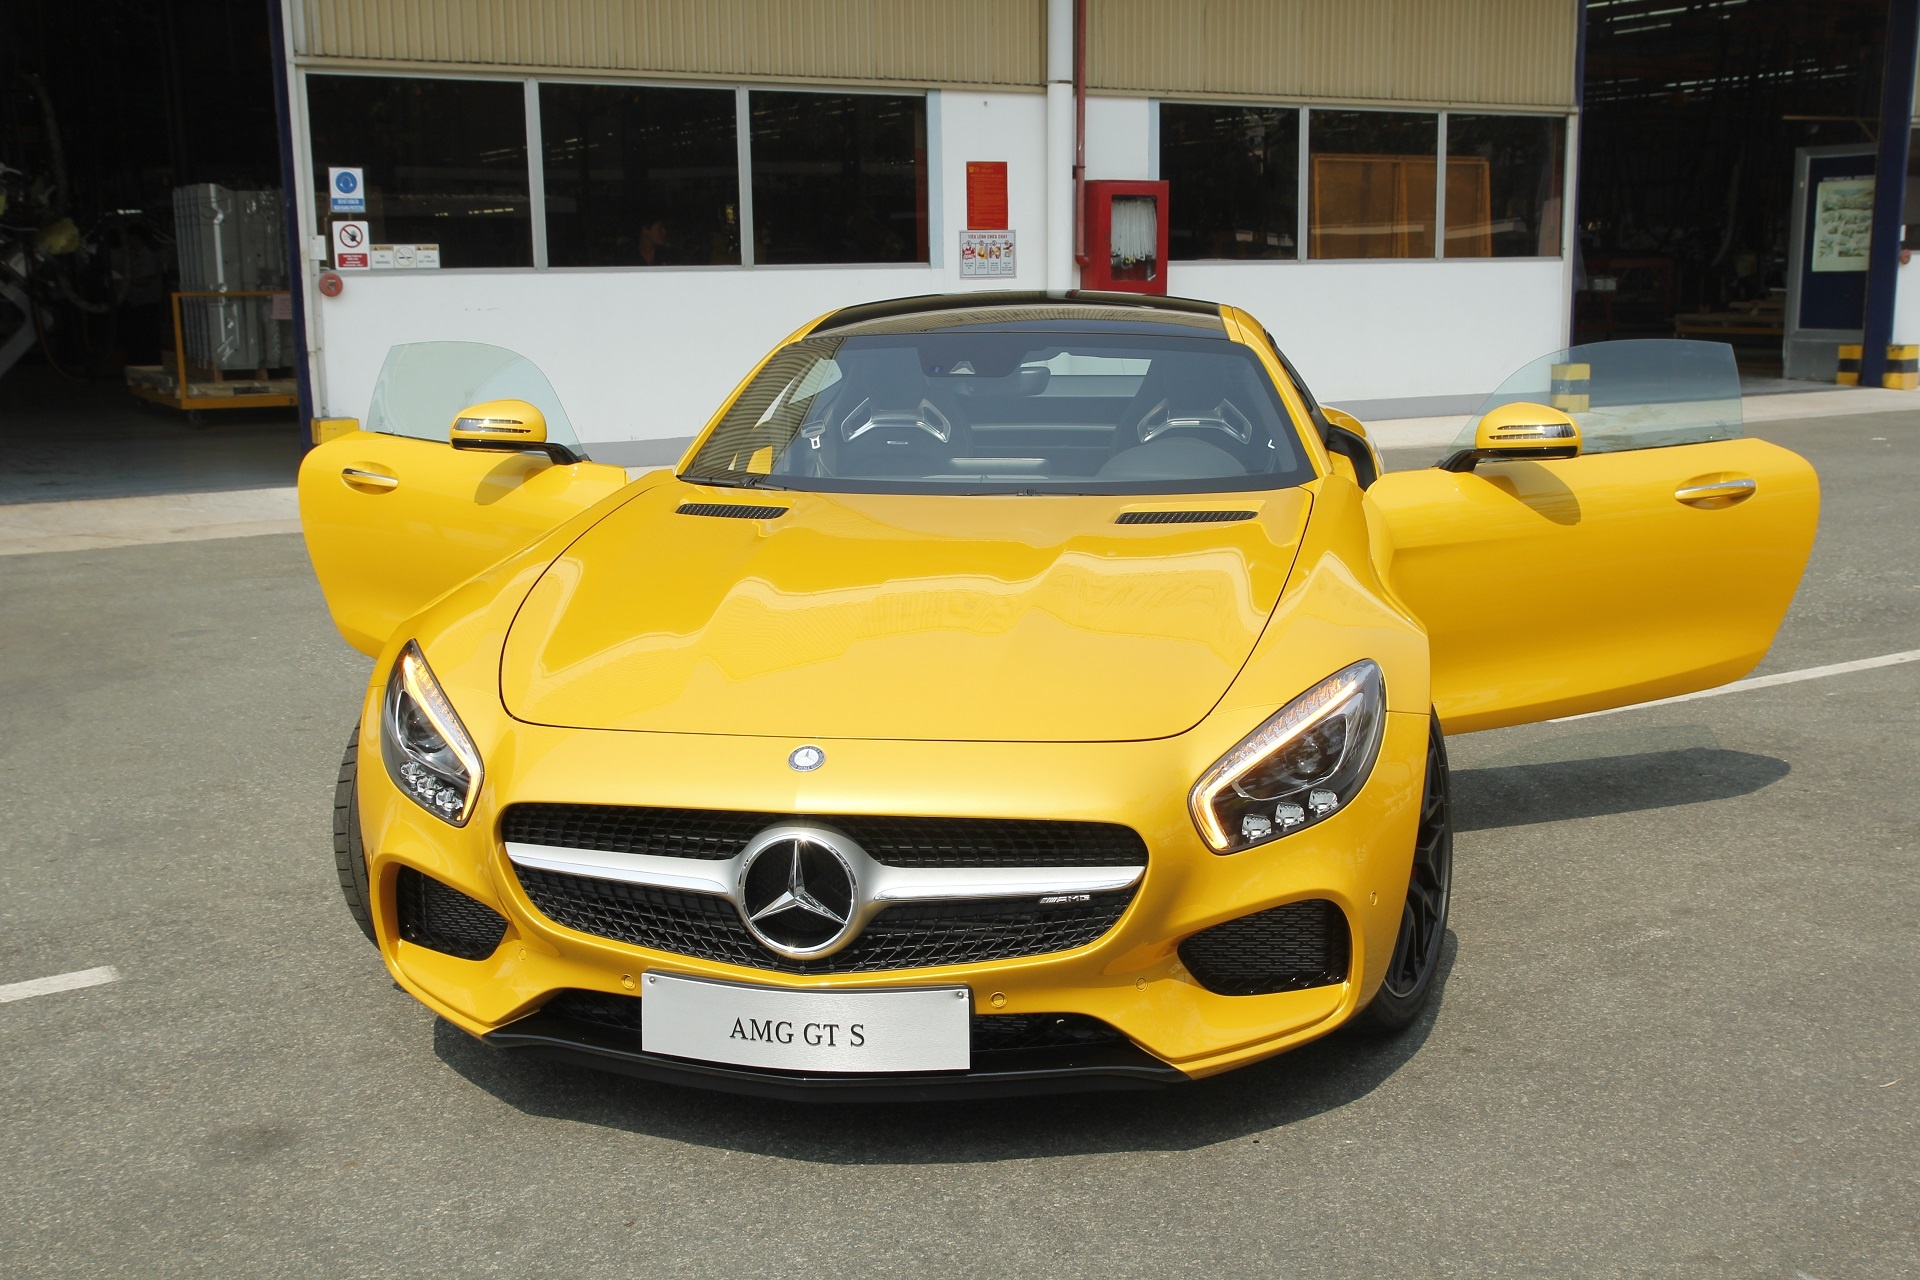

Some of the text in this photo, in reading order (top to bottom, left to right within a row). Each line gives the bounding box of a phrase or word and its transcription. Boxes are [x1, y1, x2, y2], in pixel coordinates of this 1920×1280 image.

[729, 1016, 865, 1047] AMG GT S
